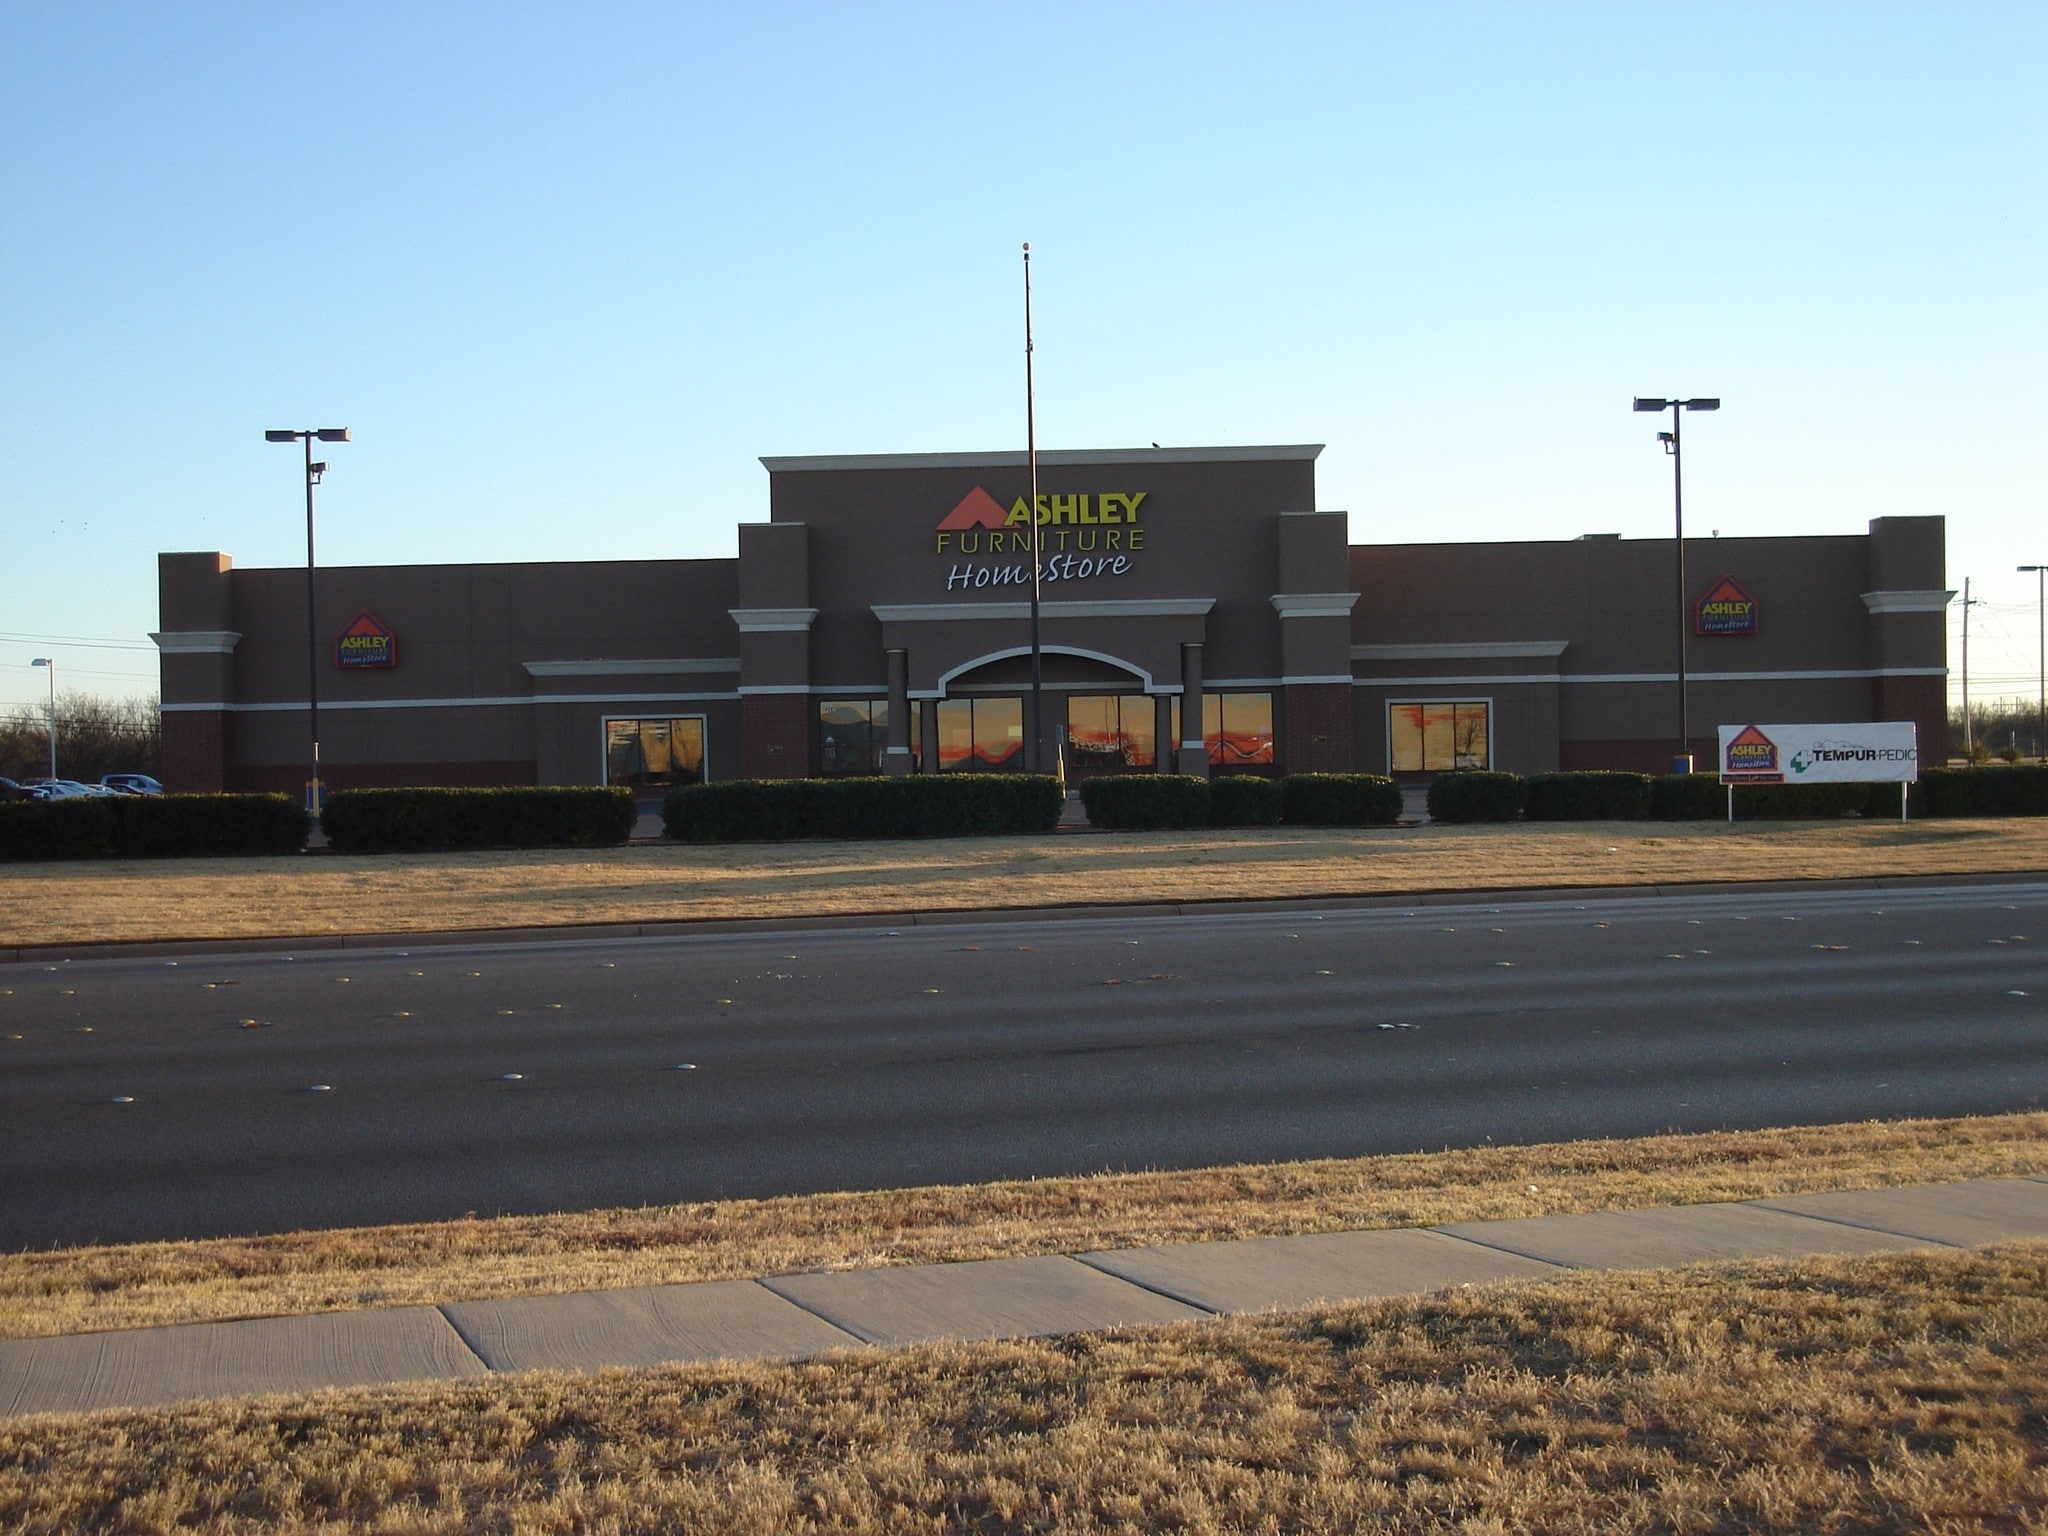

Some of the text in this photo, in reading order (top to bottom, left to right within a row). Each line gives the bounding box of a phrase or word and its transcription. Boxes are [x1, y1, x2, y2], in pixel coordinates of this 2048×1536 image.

[1003, 492, 1147, 526] ASHLEY
[936, 529, 1145, 553] FURNITURE
[1702, 602, 1752, 614] ASHLEY
[340, 636, 389, 648] ASHLEY
[1730, 745, 1772, 755] ASHLEY
